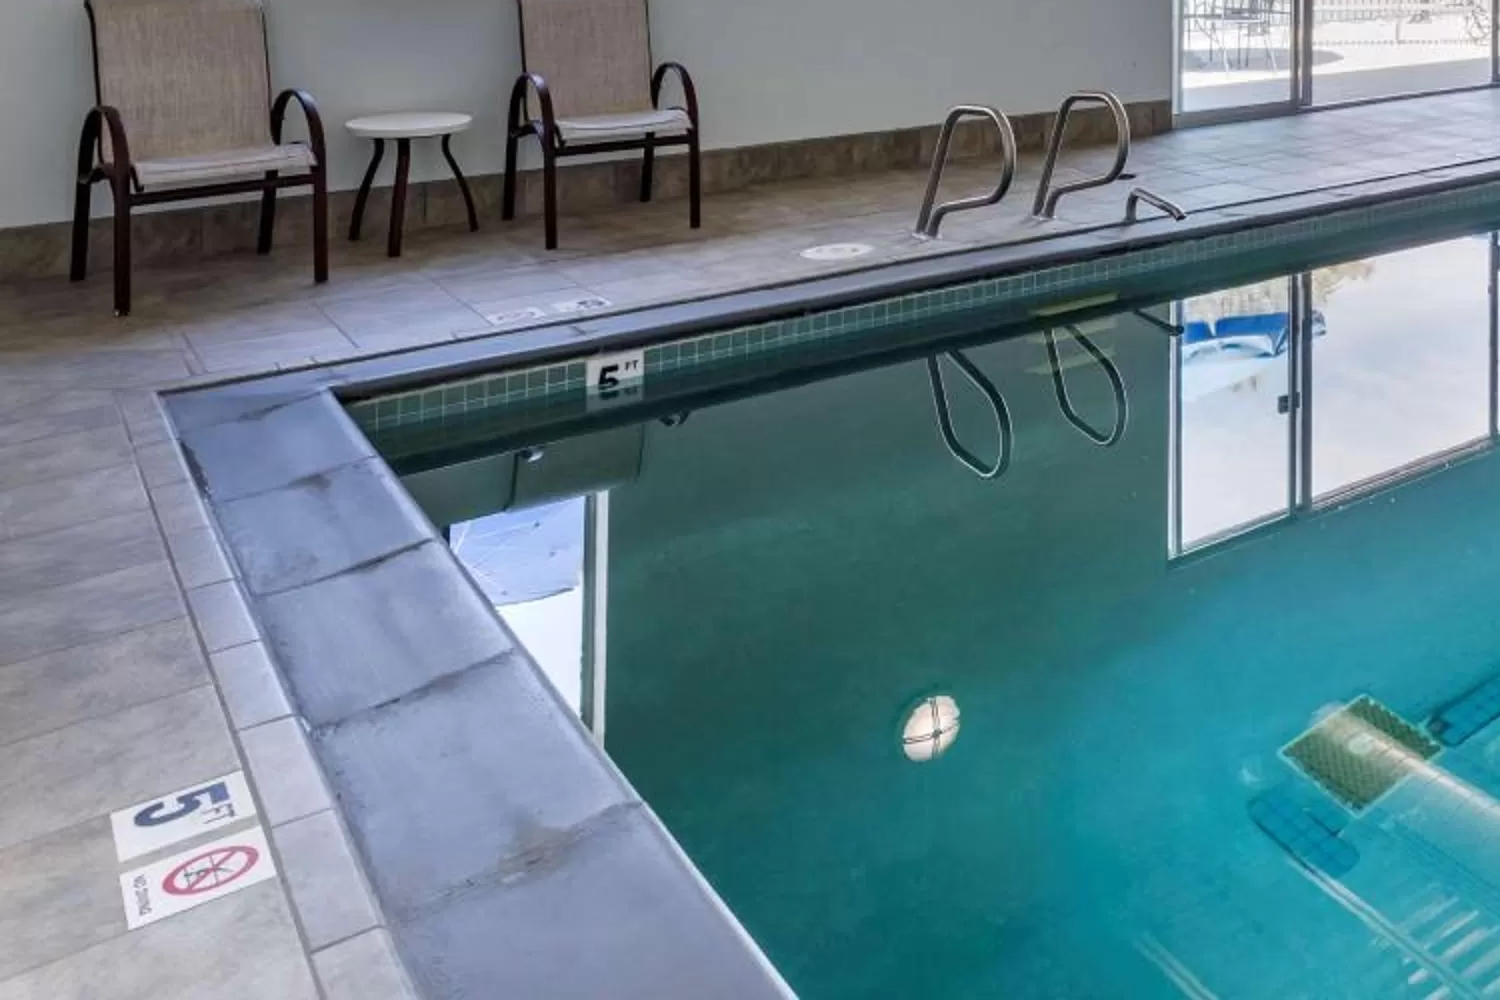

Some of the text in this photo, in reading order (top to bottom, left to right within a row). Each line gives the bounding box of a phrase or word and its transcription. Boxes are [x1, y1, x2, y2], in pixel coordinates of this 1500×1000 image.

[599, 364, 619, 390] 5
[134, 782, 236, 826] 5 FT
